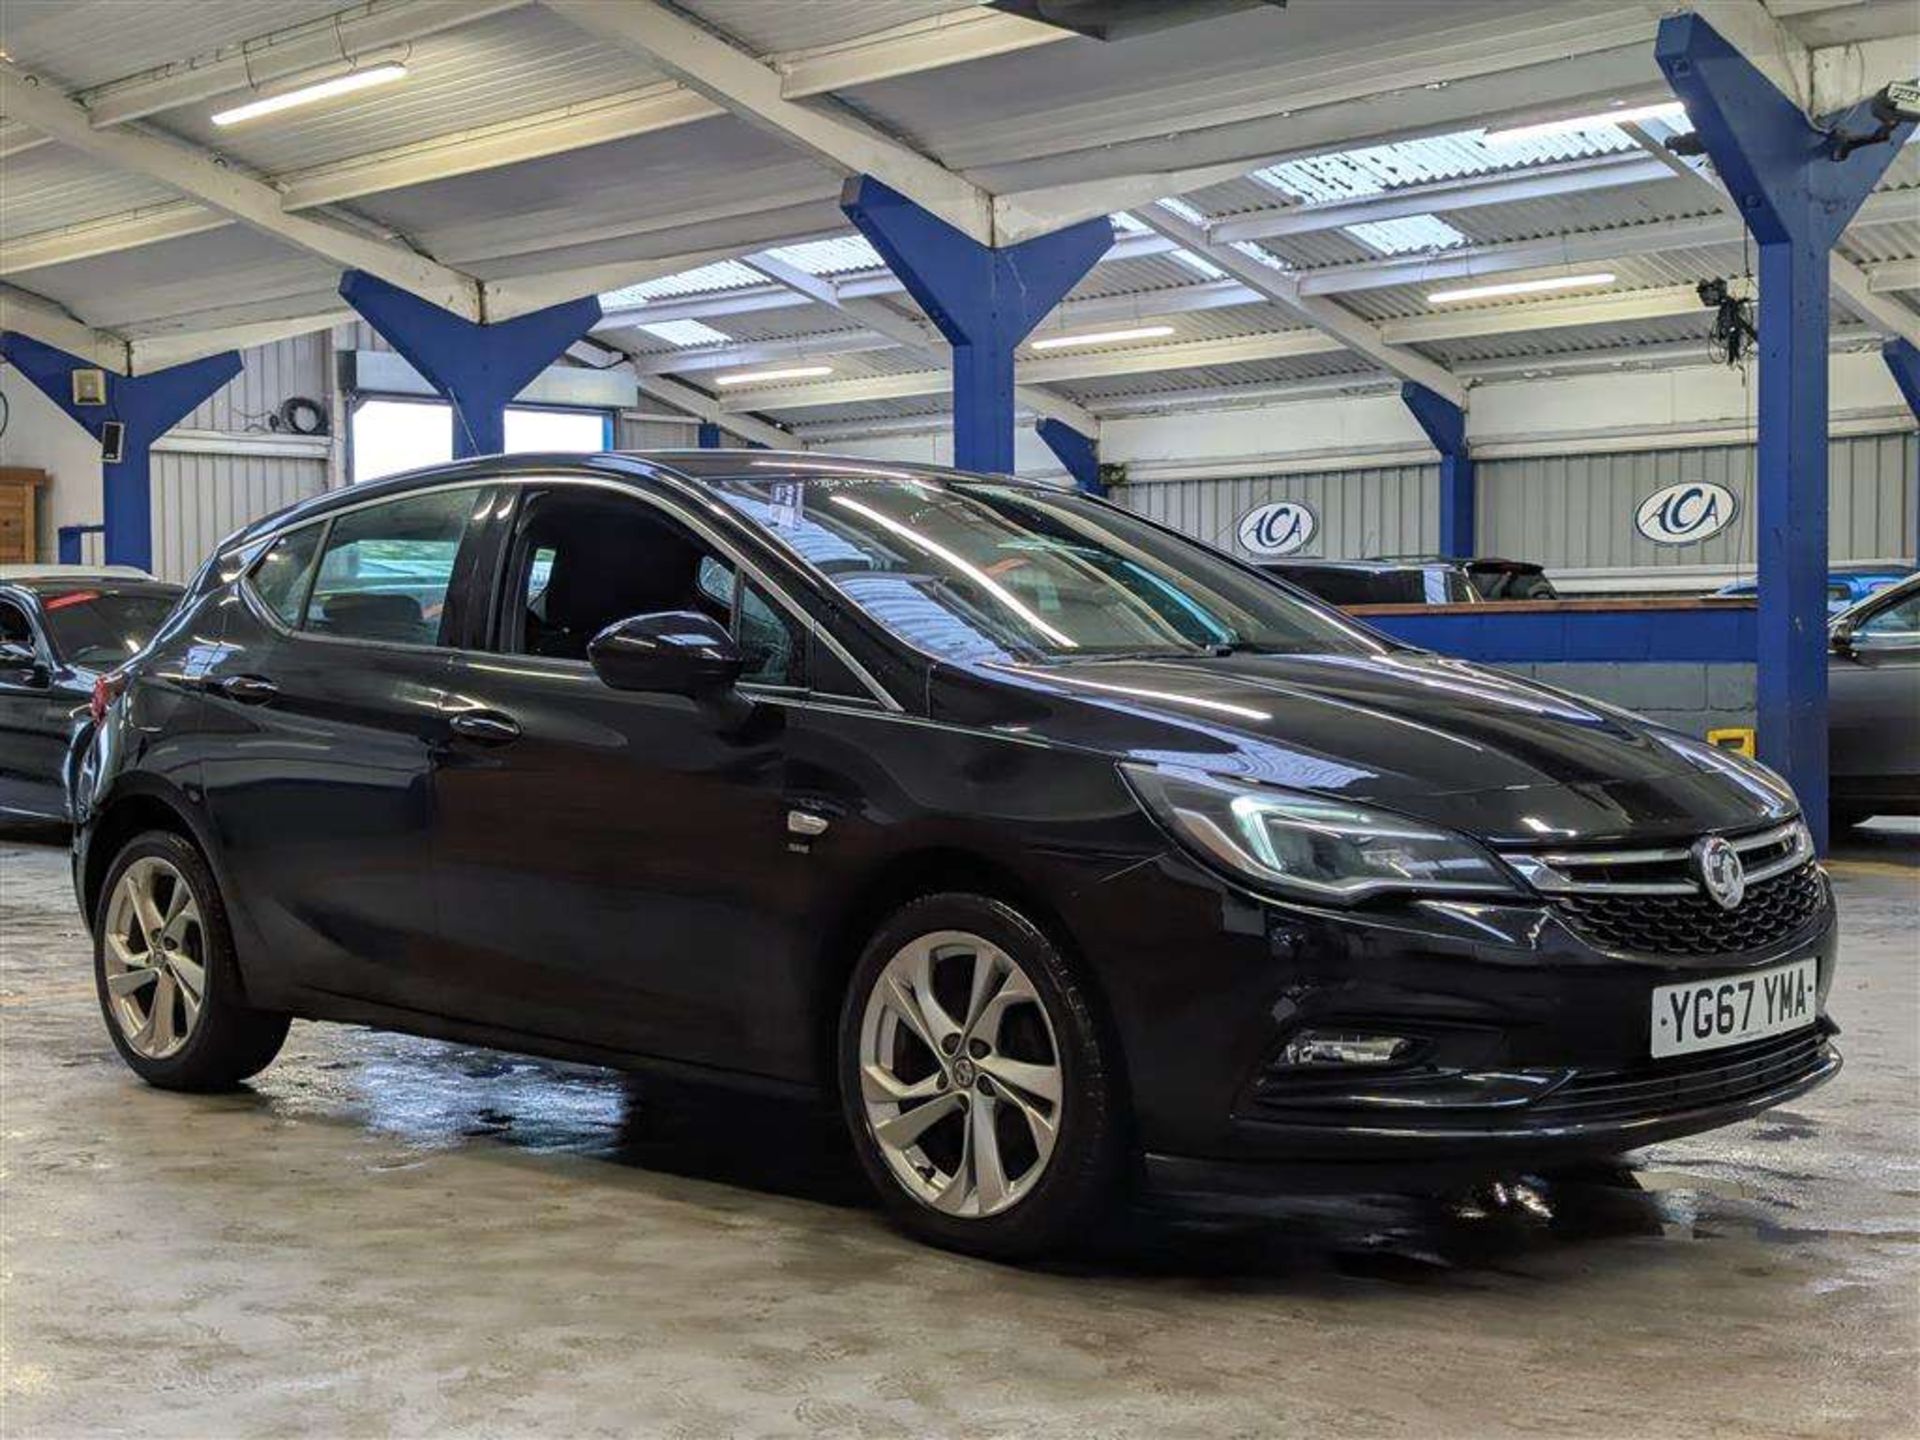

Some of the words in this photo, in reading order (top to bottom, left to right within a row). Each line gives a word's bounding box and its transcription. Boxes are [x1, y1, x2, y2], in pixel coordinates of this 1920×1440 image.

[1243, 507, 1302, 548] ACA
[1642, 488, 1719, 534] ACA
[1670, 980, 1755, 1042] YG67
[1764, 968, 1806, 1024] YMA
